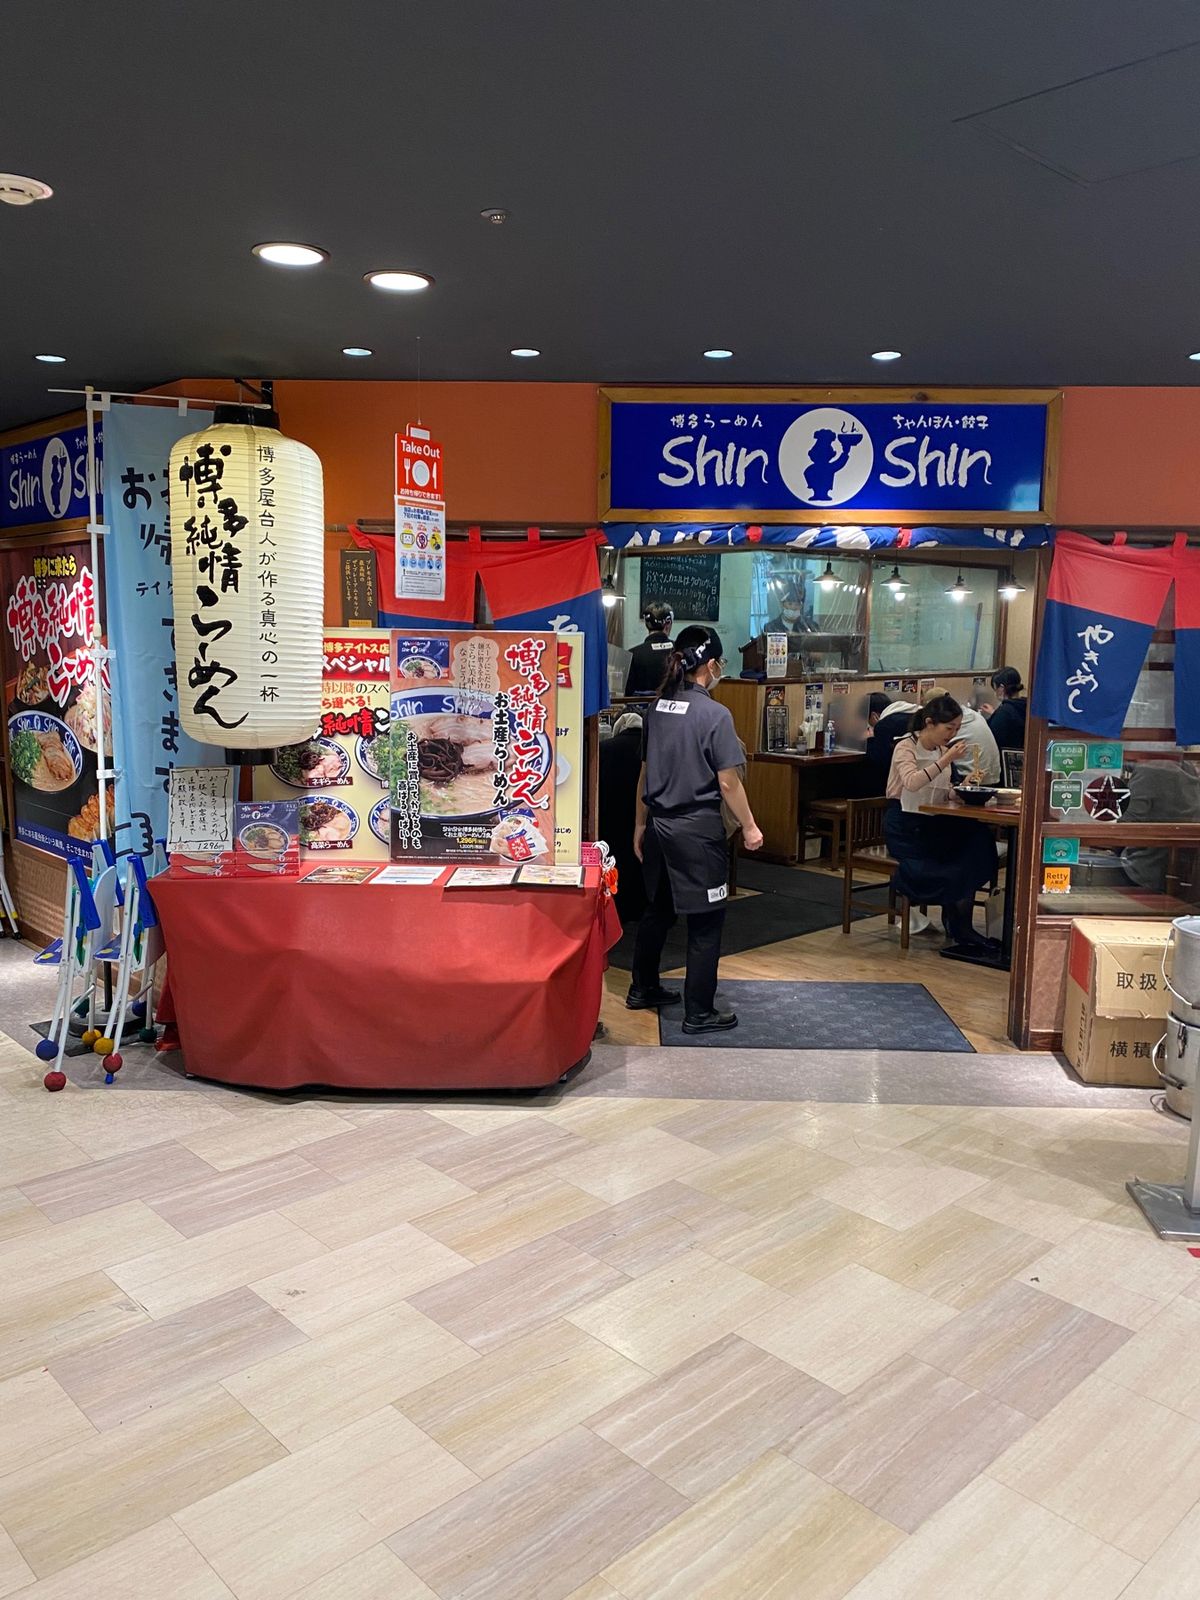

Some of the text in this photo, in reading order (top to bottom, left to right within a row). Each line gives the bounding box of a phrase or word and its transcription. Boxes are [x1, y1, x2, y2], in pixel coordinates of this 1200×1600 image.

[670, 413, 764, 430] 博多らーめん
[893, 414, 990, 430] ちゃんぽん・餃子
[400, 439, 441, 459] Take Out
[658, 434, 769, 488] Shin
[879, 435, 992, 488] Shin
[9, 468, 42, 510] Shin
[179, 442, 250, 730] 博多純情らーめん
[256, 444, 280, 703] 博多屋台人が作る真心の一杯
[1065, 624, 1115, 713] やきめし
[493, 692, 510, 806] お土産らーめん
[505, 638, 549, 807] 博多純情らーめん
[1046, 872, 1069, 882] Retty
